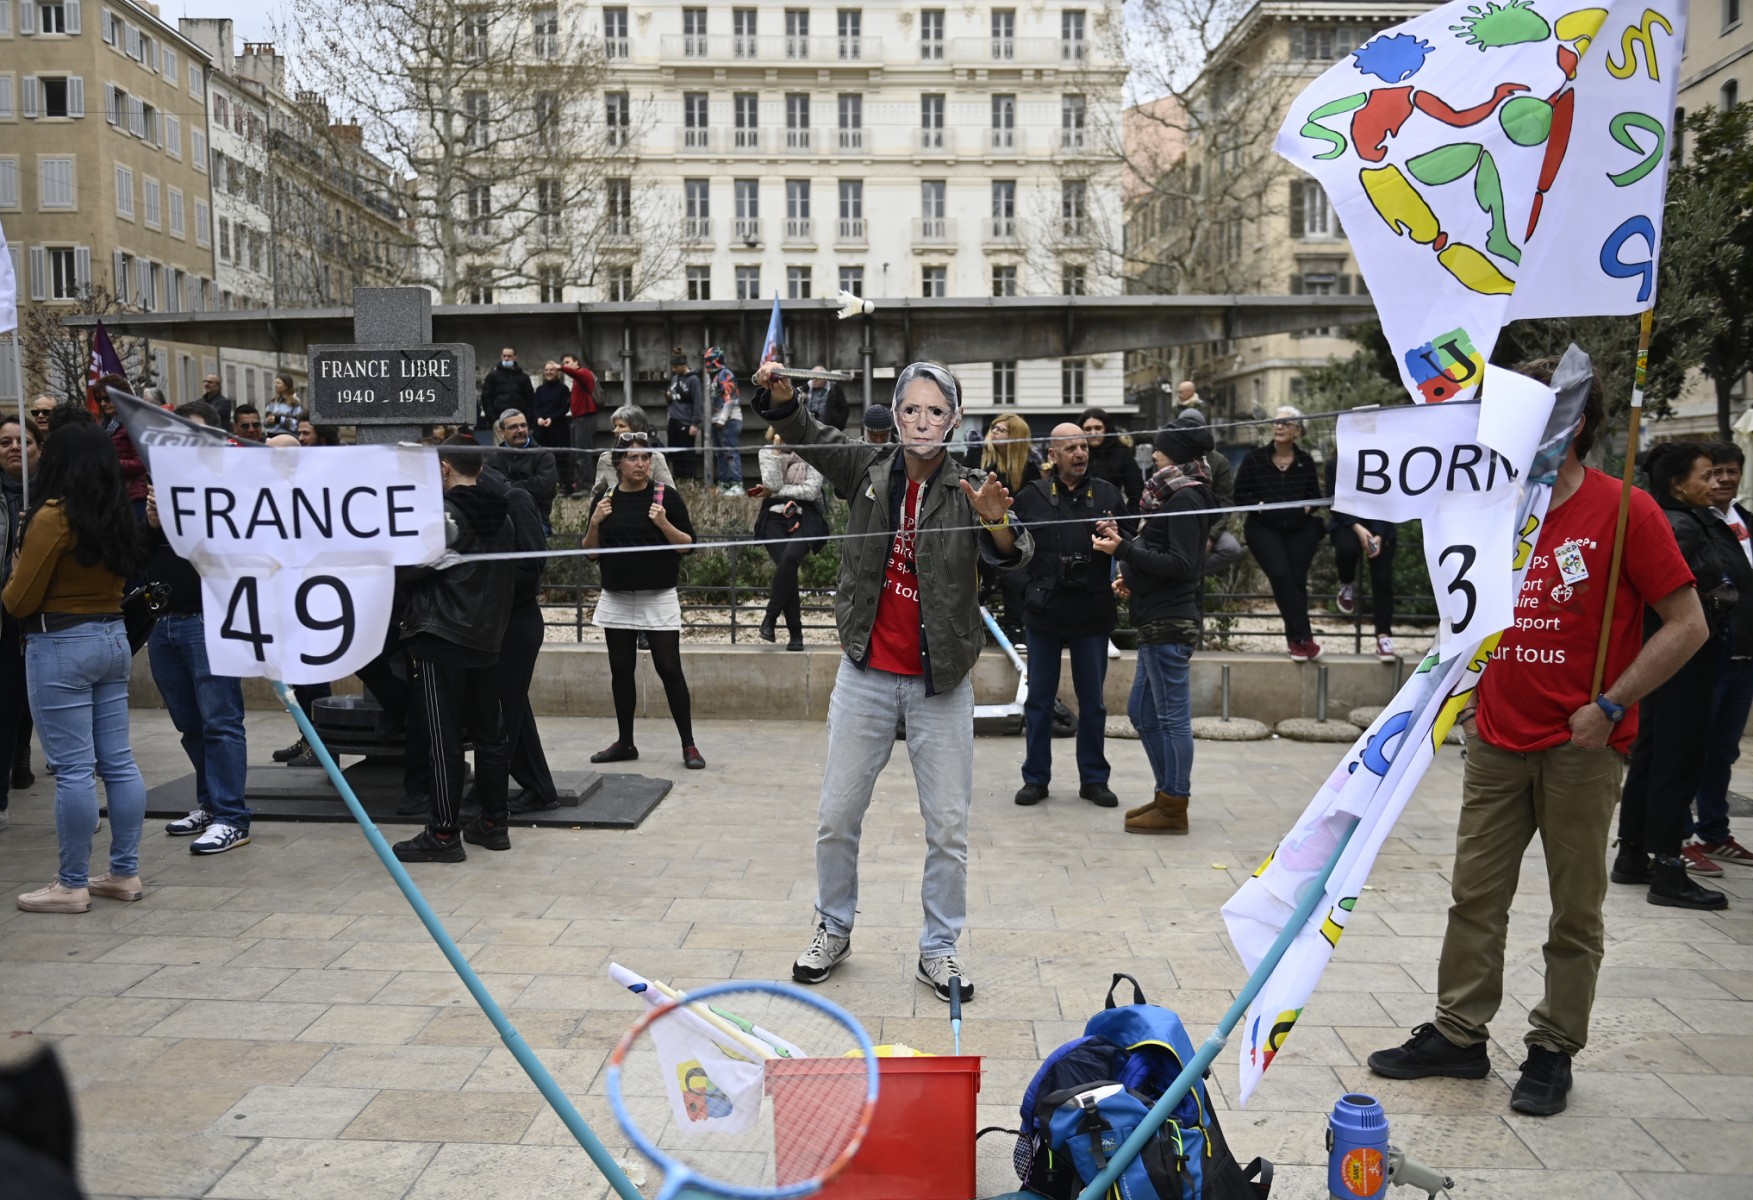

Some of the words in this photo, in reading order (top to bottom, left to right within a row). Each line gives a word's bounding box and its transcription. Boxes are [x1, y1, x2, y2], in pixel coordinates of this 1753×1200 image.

[321, 360, 390, 378] FRANCE
[400, 359, 451, 378] LIBRE
[337, 389, 375, 403] 1940
[399, 389, 436, 403] 1945
[171, 484, 419, 541] FRANCE
[1438, 544, 1477, 634] 3
[221, 574, 356, 666] 49
[1515, 616, 1561, 631] sport
[1515, 644, 1566, 664] tous
